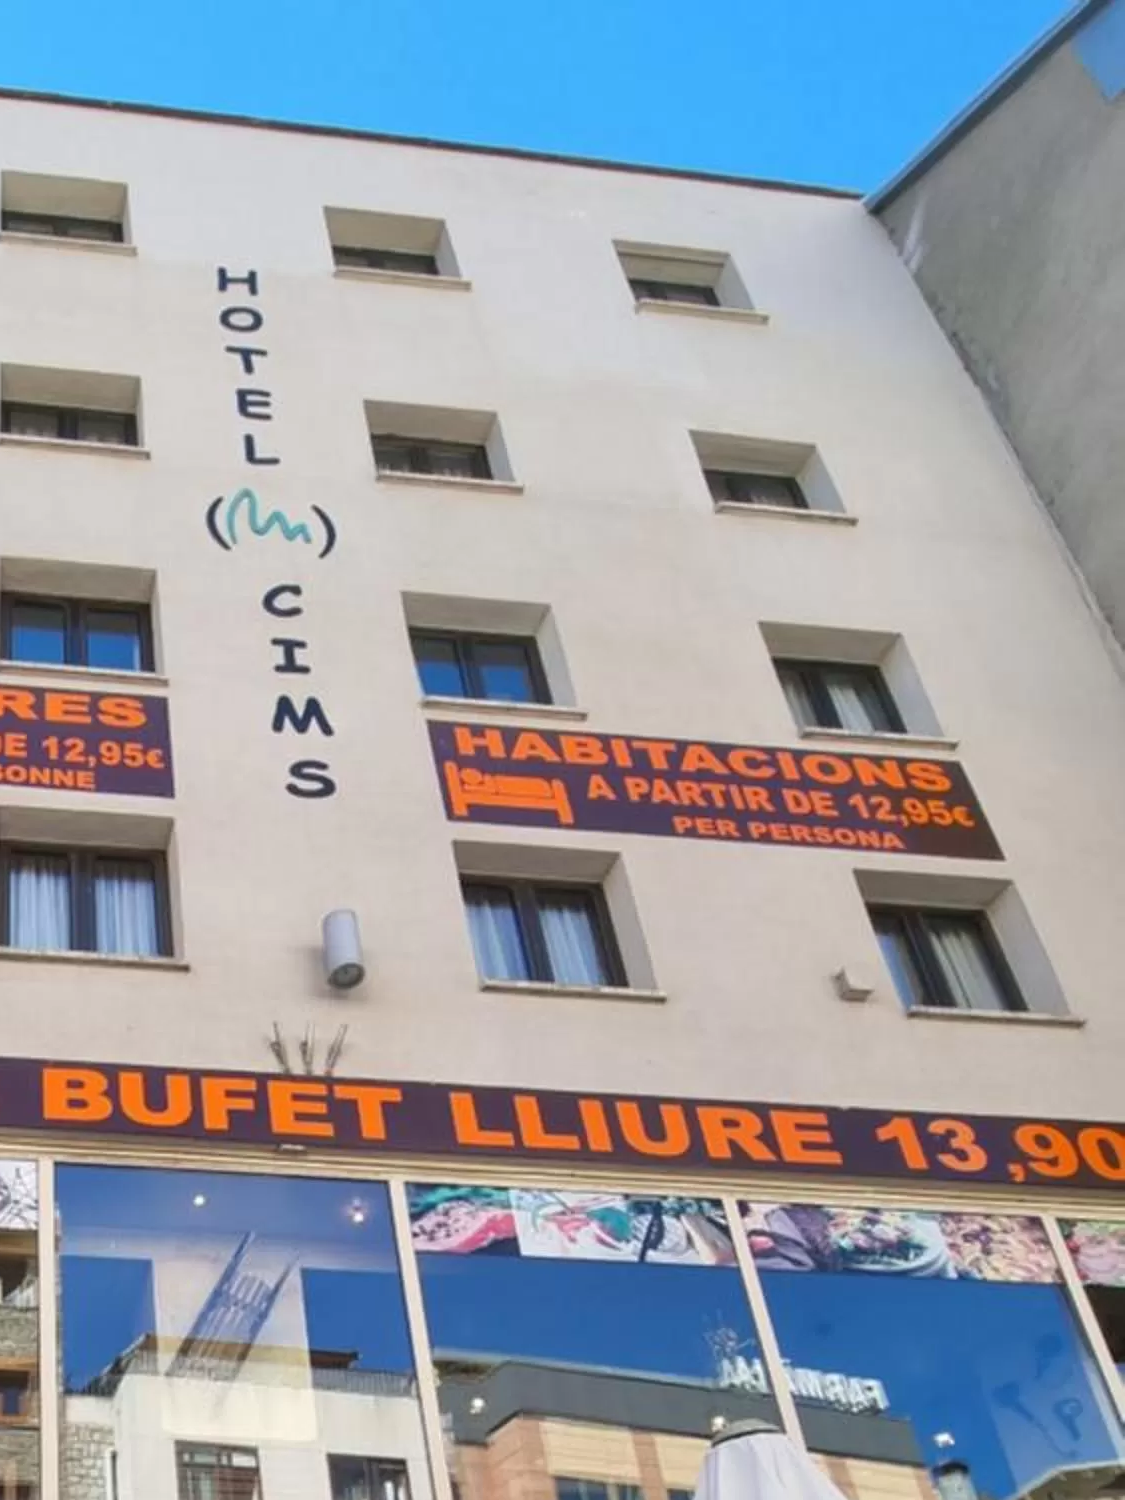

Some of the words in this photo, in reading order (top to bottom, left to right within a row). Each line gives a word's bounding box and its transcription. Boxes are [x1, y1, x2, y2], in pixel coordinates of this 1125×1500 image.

[217, 267, 280, 465] HOTEL
[262, 584, 336, 799] CIMS
[41, 736, 166, 769] 12,95€
[454, 726, 953, 793] HABITACIONS
[587, 774, 617, 801] A
[625, 777, 776, 812] PARTIR
[782, 788, 839, 818] DE
[848, 793, 976, 829] 12,95€
[673, 815, 740, 838] PER
[747, 820, 906, 850] PERSONA
[42, 1067, 402, 1141] BUFET
[449, 1091, 843, 1166] LLIURE
